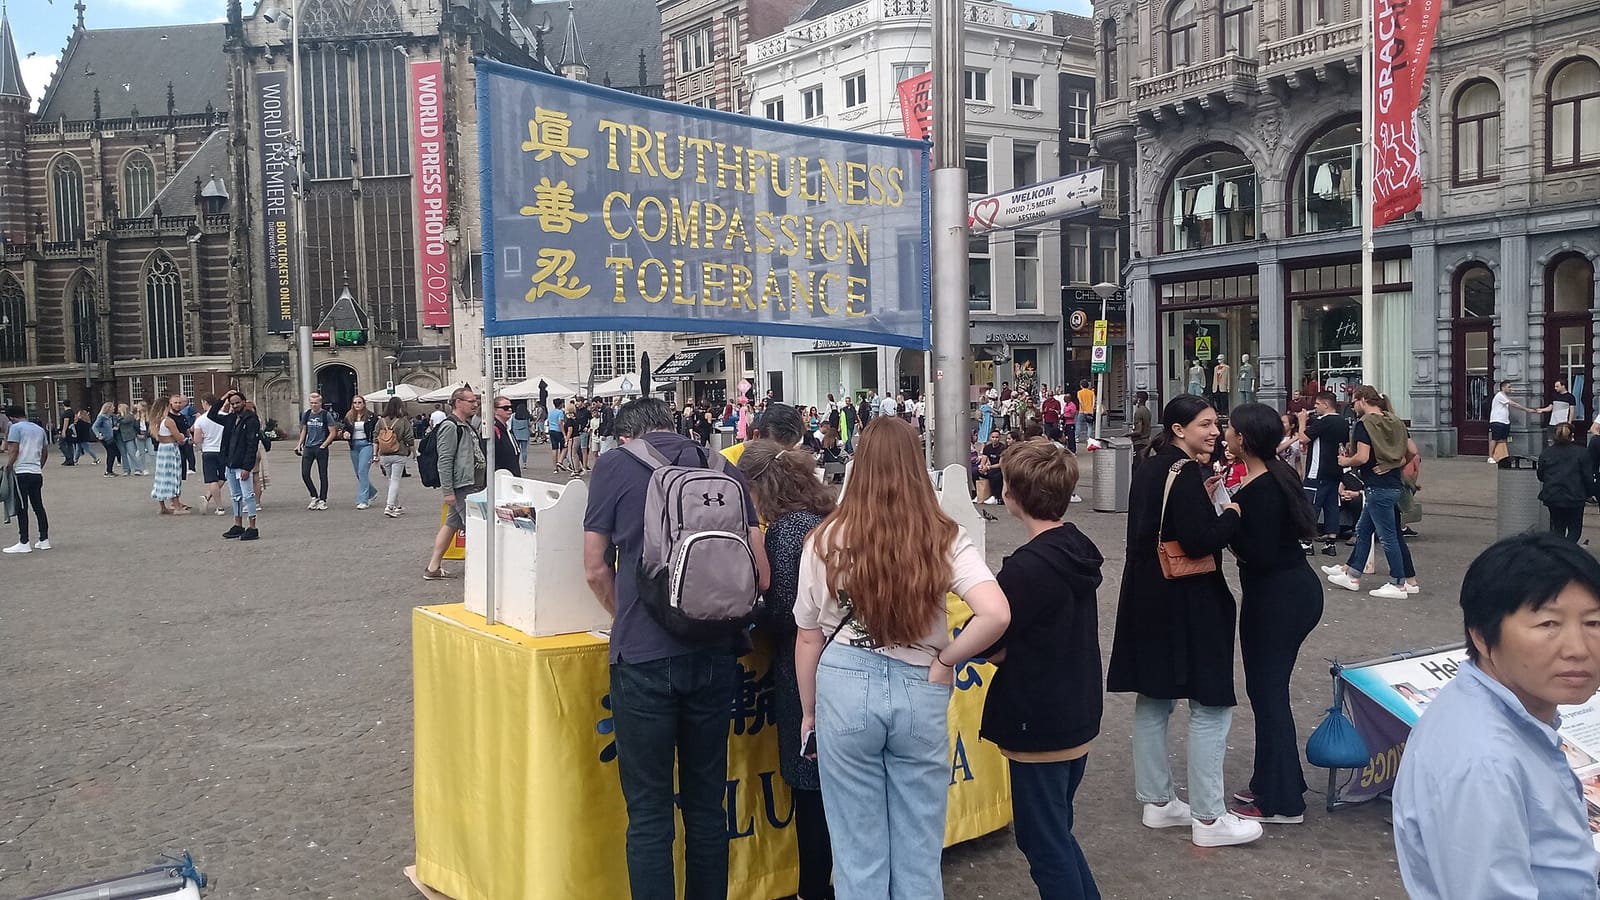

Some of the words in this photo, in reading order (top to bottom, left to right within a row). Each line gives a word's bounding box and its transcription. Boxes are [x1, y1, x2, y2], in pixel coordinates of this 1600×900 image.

[1421, 14, 1430, 28] 250
[262, 83, 281, 137] WORLD
[418, 74, 438, 138] WORLD
[265, 142, 285, 216] PREMIERE
[421, 142, 442, 193] PRESS
[598, 119, 905, 208] TRUTHFULNESS
[1005, 204, 1025, 215] HOUD
[1026, 202, 1036, 212] 1,5
[1035, 197, 1057, 209] METER
[1011, 186, 1055, 204] WELKOM
[267, 221, 277, 269] nieuwekerk.nl
[276, 221, 287, 246] BOOK
[424, 198, 444, 255] PHOTO
[602, 191, 869, 267] COMPASSION
[278, 248, 289, 286] TICKETS
[426, 262, 448, 317] 2021
[605, 256, 868, 318] TOLERANCE
[280, 287, 291, 320] ONLINE
[1420, 657, 1461, 681] Hel
